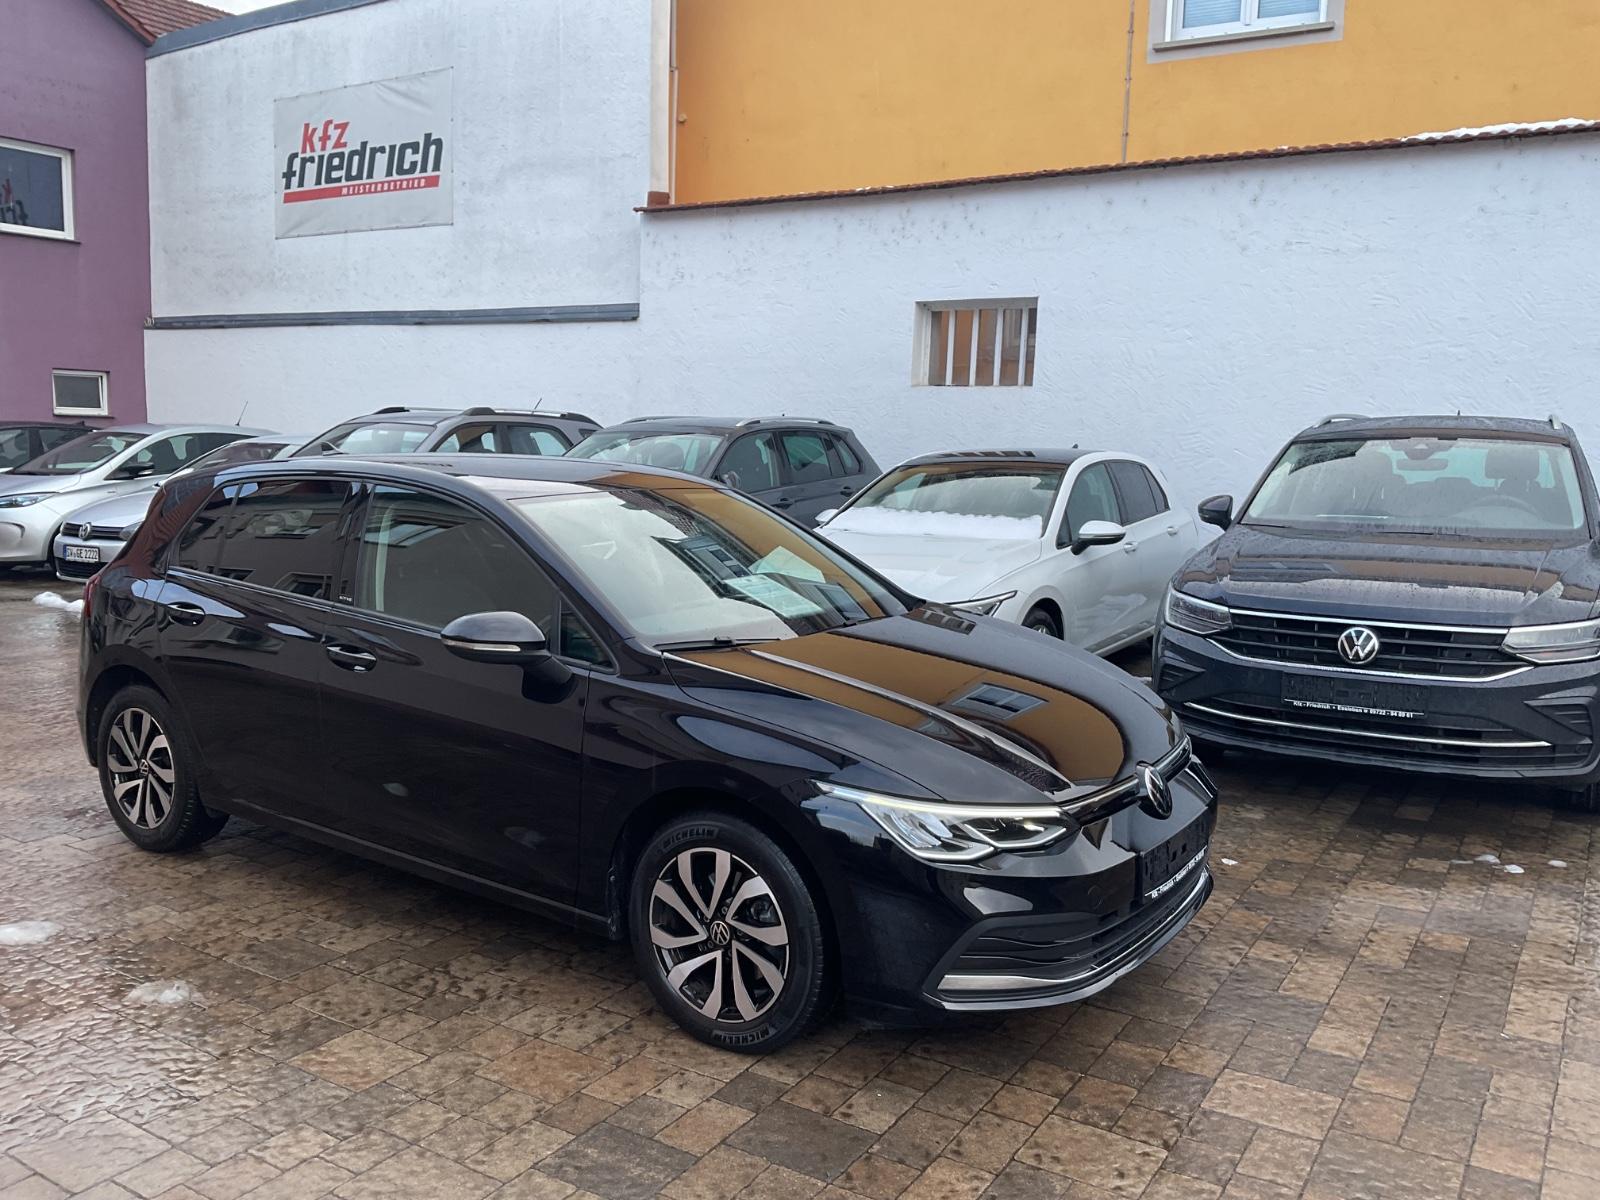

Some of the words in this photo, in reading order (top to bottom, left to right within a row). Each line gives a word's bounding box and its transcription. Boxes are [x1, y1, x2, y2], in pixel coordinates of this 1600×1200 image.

[282, 132, 443, 190] friedrich
[341, 178, 427, 195] MEISTERBETRIEB
[663, 827, 716, 849] MICHELIN
